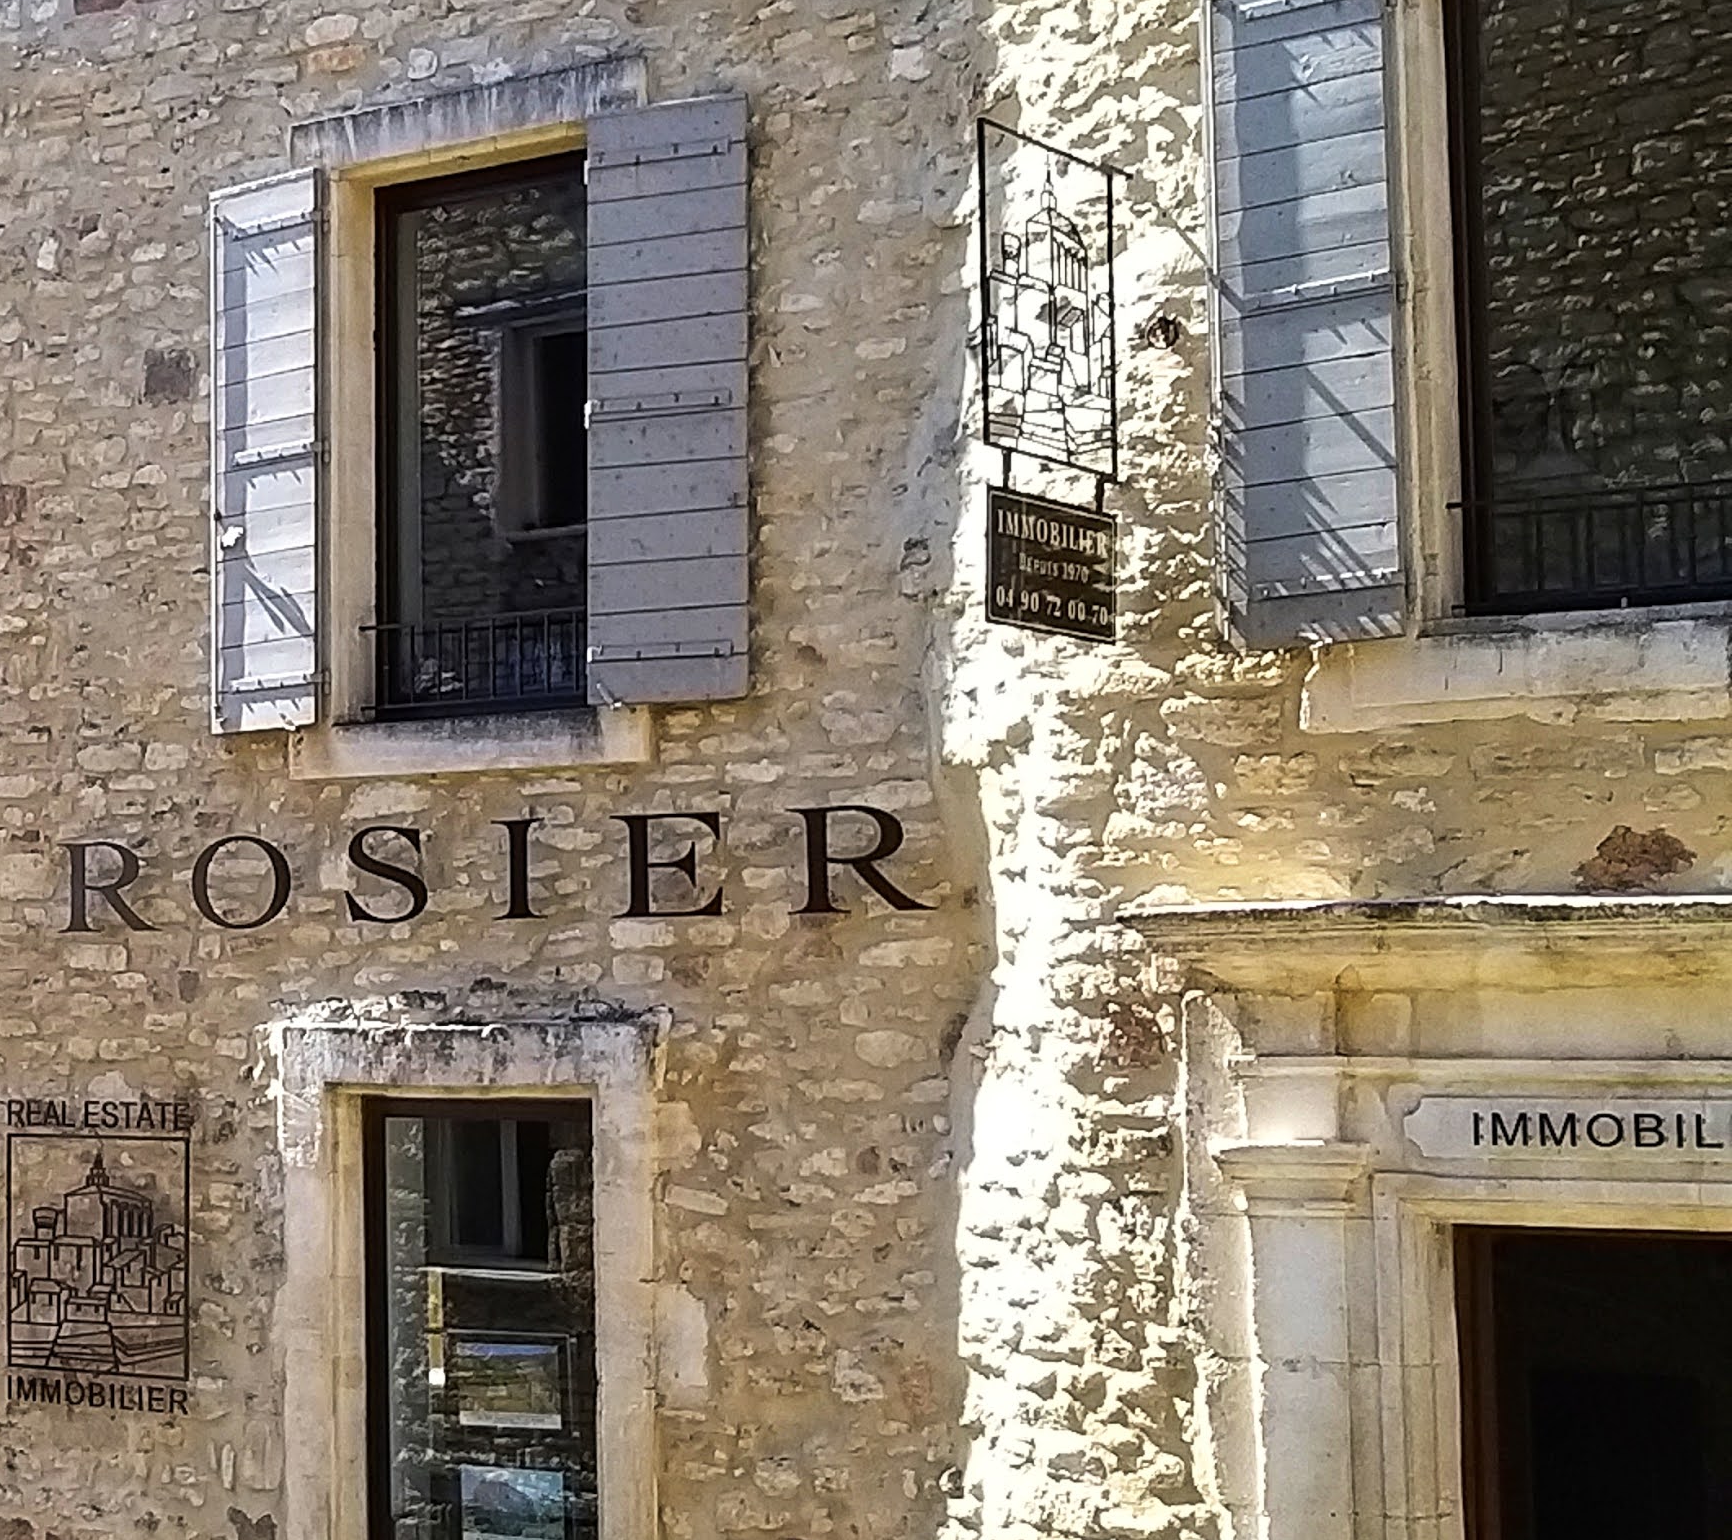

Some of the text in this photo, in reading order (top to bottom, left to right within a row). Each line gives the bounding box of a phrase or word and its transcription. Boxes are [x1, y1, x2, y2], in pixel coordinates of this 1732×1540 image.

[997, 509, 1108, 559] IMMOBILIER
[1063, 562, 1090, 584] 1970
[996, 586, 1108, 625] 04 90 72 00 70
[58, 804, 942, 934] ROSIER
[7, 1099, 191, 1130] REAL ESTATE
[1472, 1112, 1732, 1149] IMMOBIL
[7, 1374, 189, 1415] IMMOBILIER
